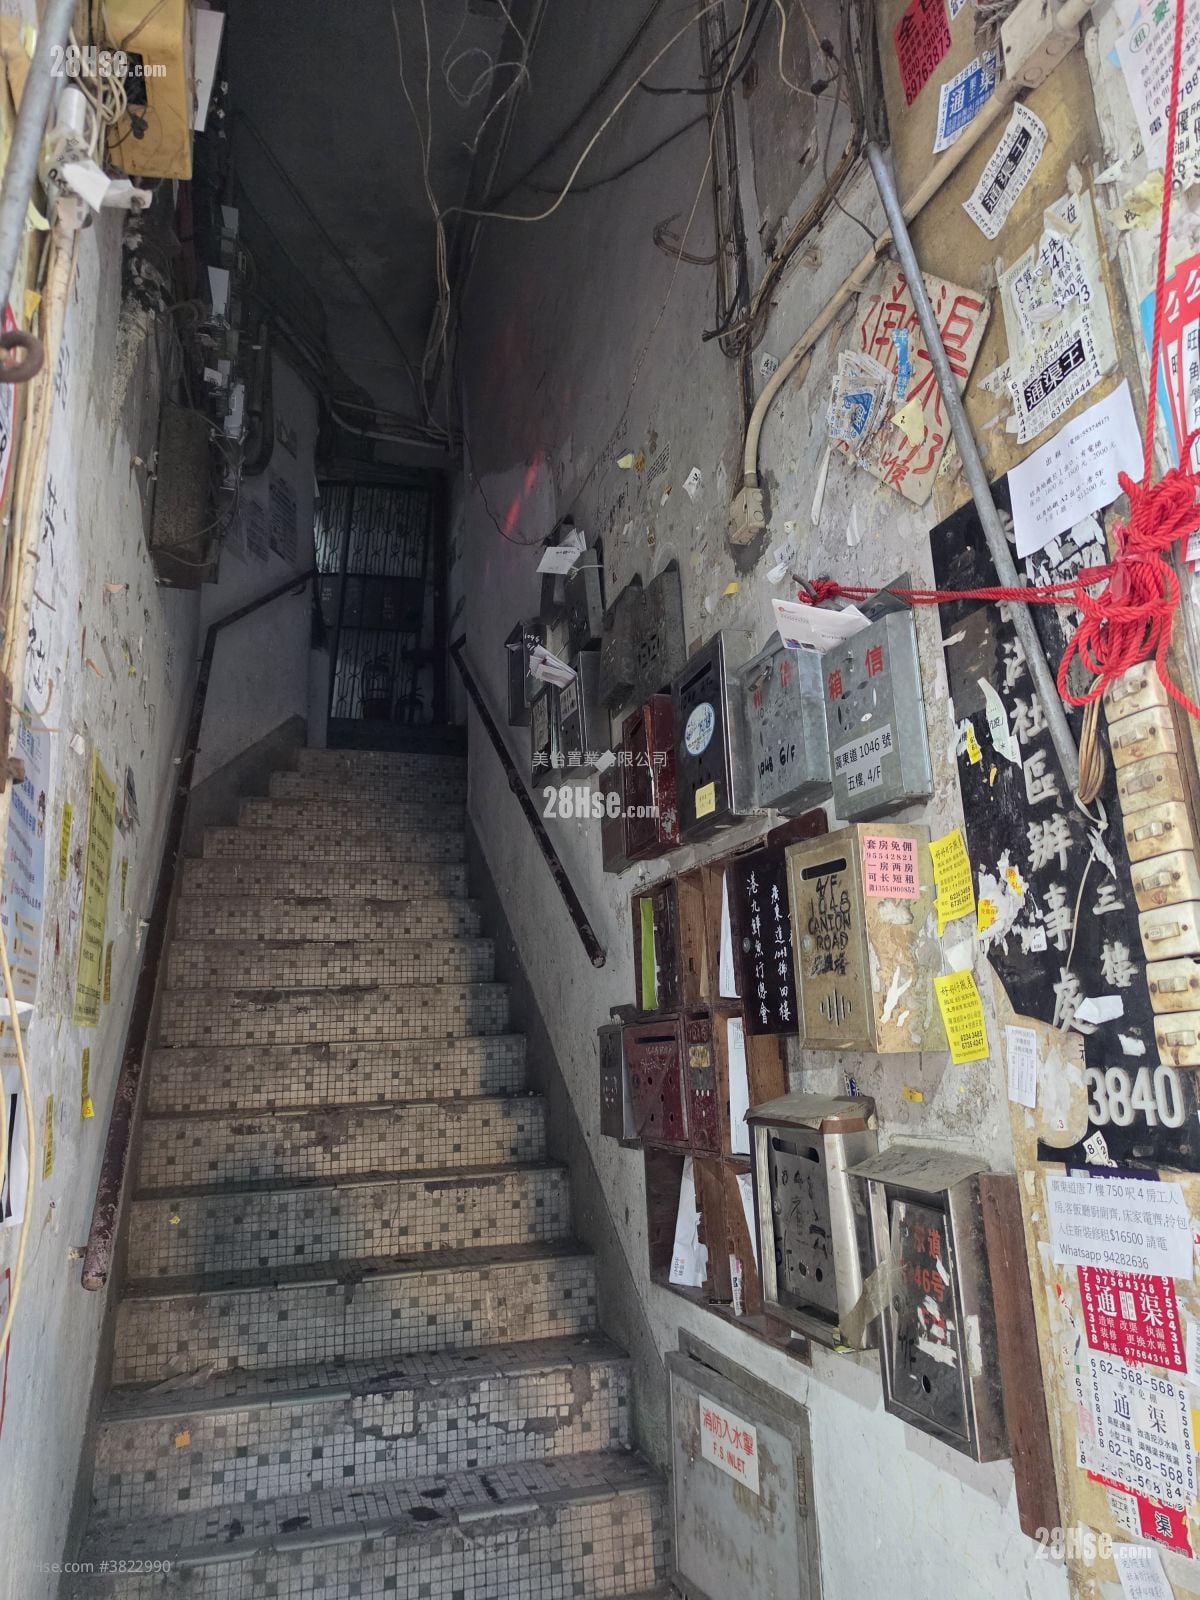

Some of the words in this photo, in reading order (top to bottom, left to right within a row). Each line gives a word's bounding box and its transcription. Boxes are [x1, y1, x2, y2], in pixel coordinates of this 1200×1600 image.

[905, 28, 952, 106] 69763873
[1026, 342, 1084, 410] 通渠王
[1051, 379, 1091, 419] 63184444
[834, 749, 858, 770] 廣東道
[859, 739, 881, 759] 1046
[881, 732, 892, 748] 號
[867, 765, 882, 785] 4/F
[866, 839, 913, 852] 套房免佣
[866, 852, 913, 861] 95542821
[815, 931, 849, 950] ROAD
[1086, 1066, 1185, 1128] 3840
[1106, 1184, 1124, 1198] 750
[1060, 1243, 1102, 1264] Whatsapp
[1103, 1250, 1149, 1270] 94282636
[1096, 1275, 1155, 1294] 97564318
[1095, 1284, 1118, 1317] 通
[1139, 1292, 1164, 1326] 渠
[1161, 1277, 1182, 1365] 97564318
[1100, 1359, 1174, 1397] 62-568-568
[1113, 1391, 1131, 1420] 通
[1147, 1404, 1167, 1434] 渠
[726, 1451, 746, 1474] INLET
[1108, 1440, 1183, 1485] 62-568-568
